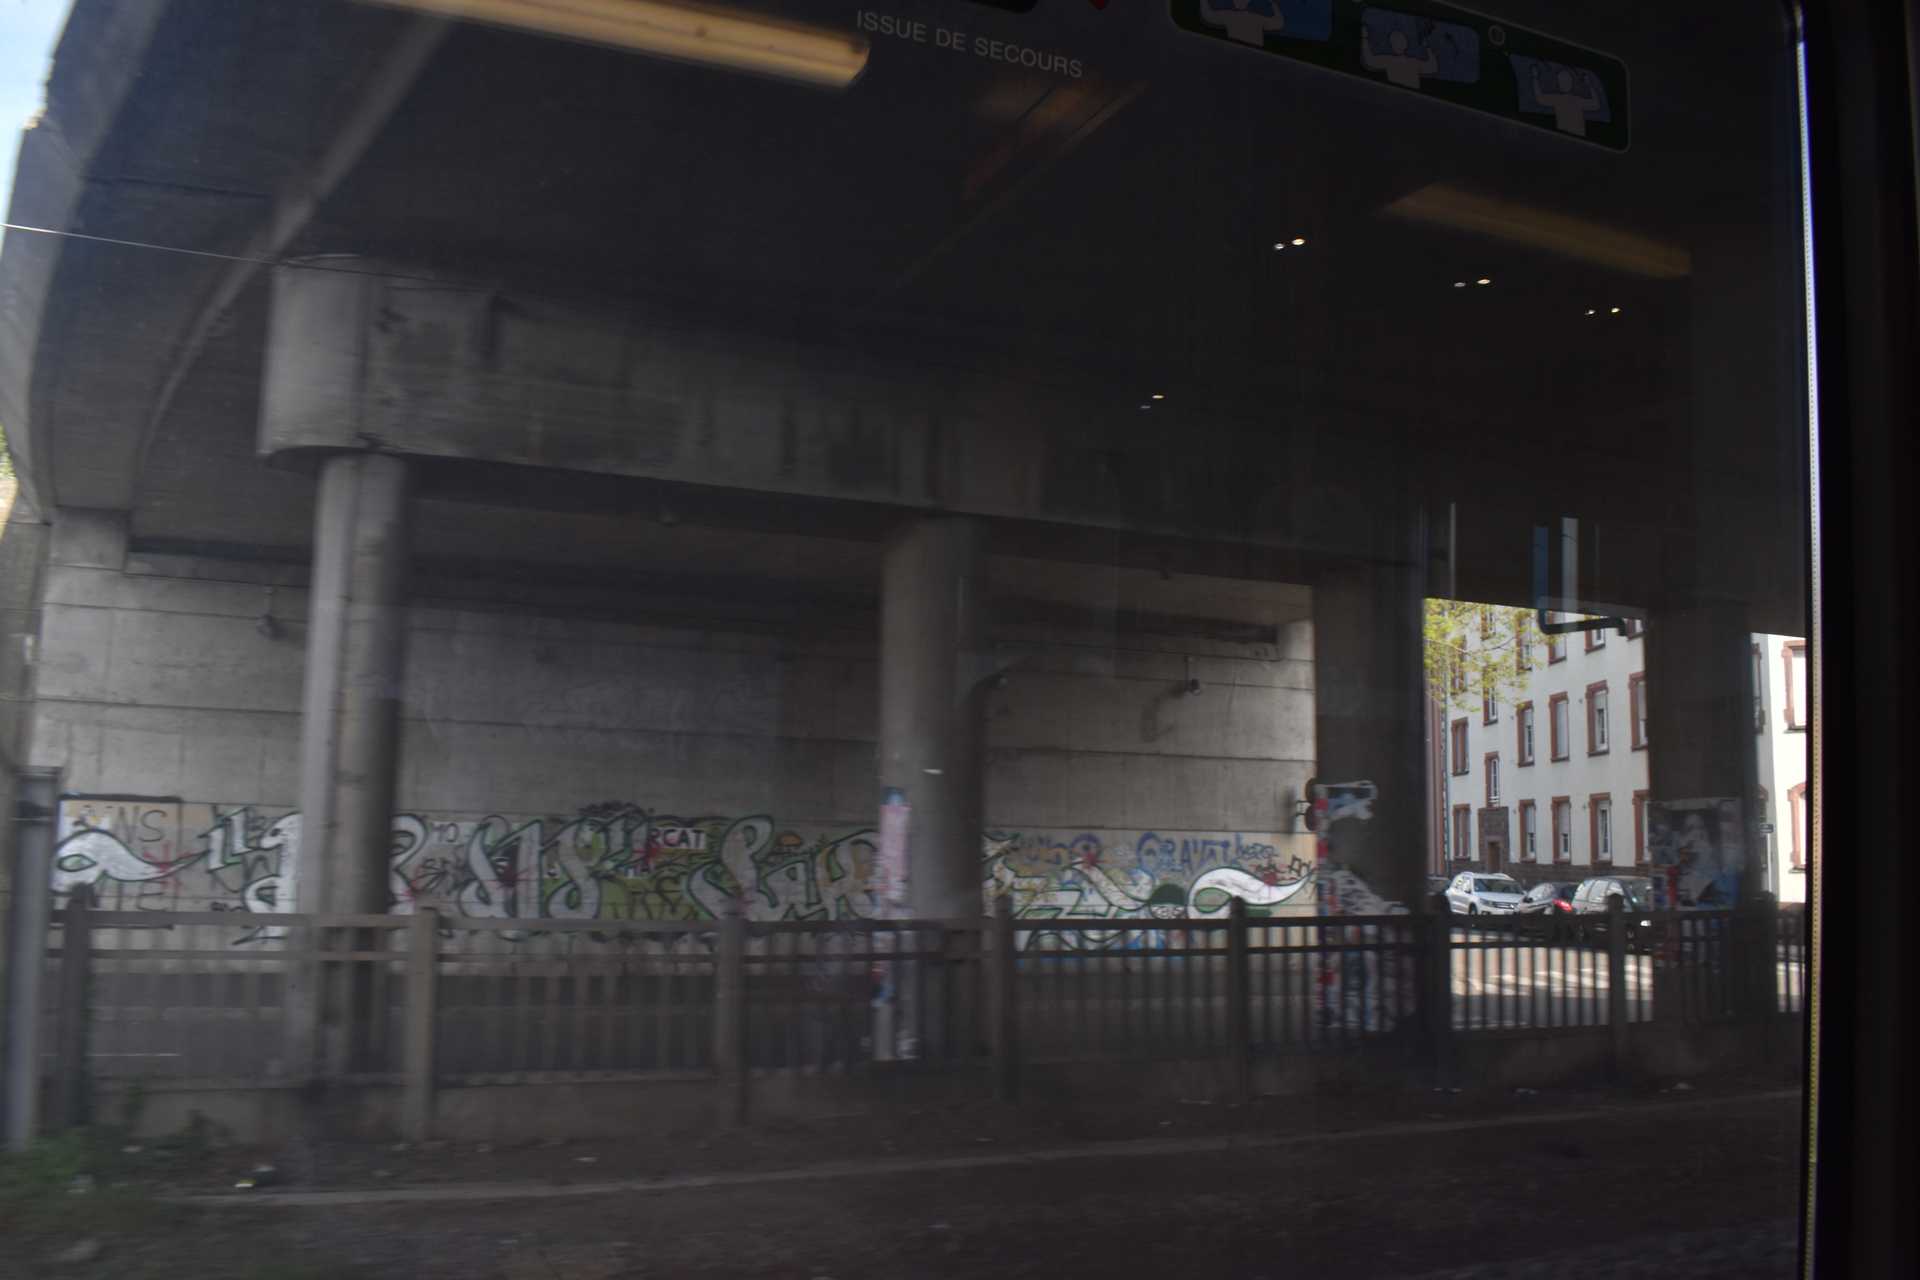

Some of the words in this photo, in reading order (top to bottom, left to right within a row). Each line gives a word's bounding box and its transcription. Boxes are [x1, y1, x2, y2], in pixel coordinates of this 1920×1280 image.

[856, 9, 928, 43] ISSUE
[935, 27, 967, 51] DE
[974, 37, 1084, 78] SECOURS
